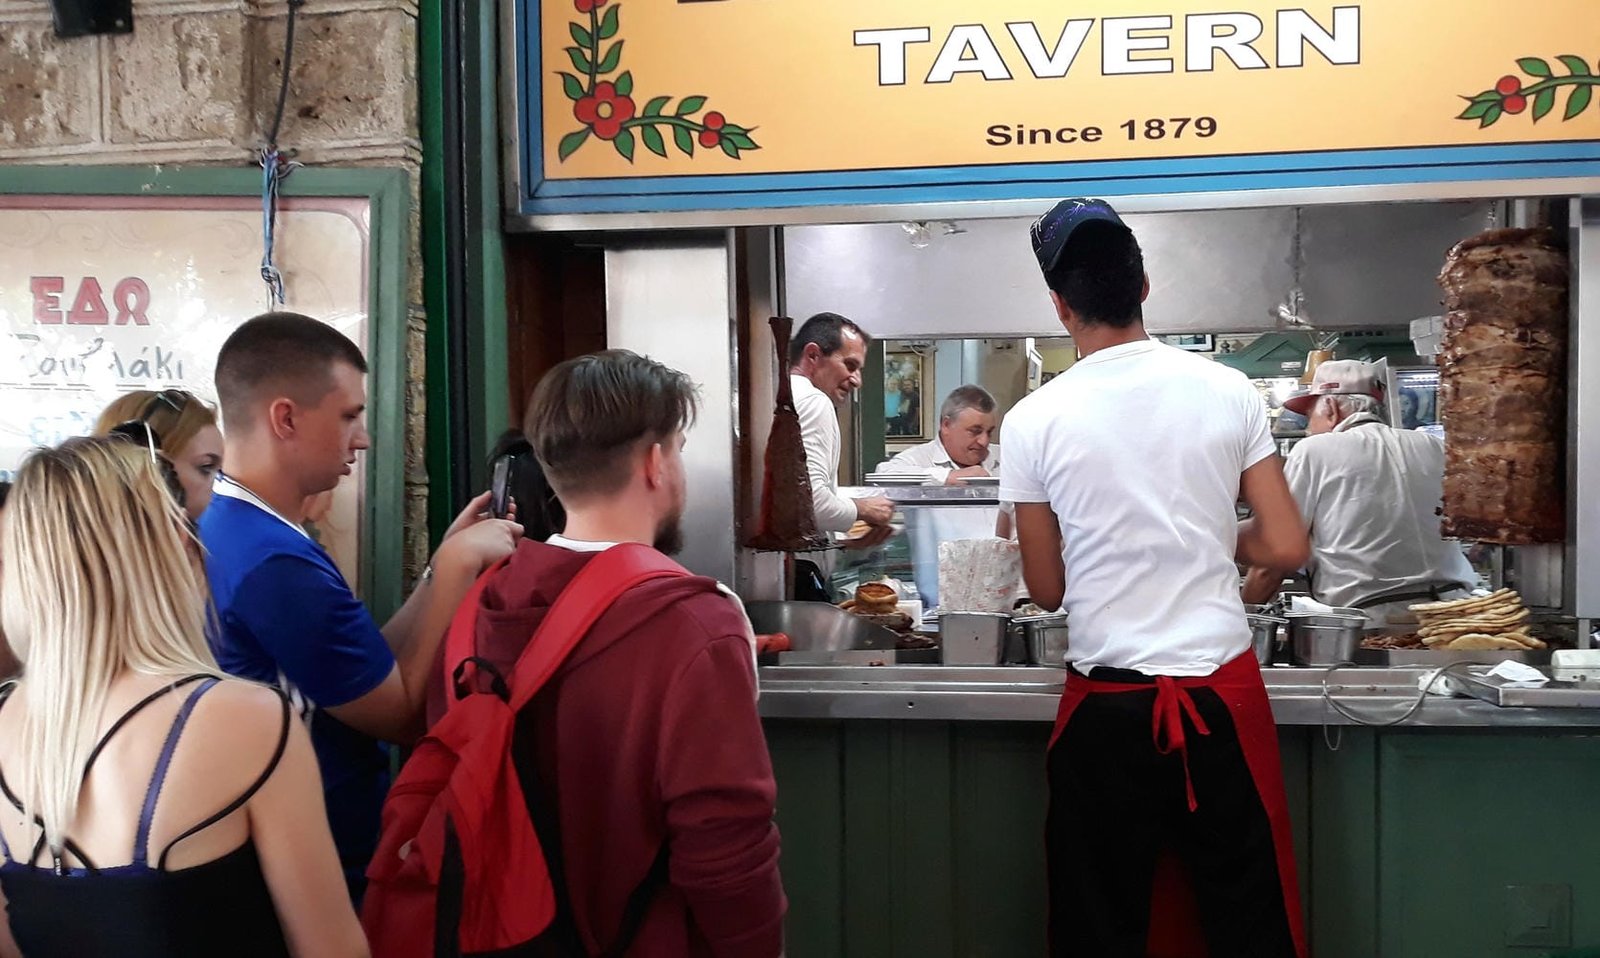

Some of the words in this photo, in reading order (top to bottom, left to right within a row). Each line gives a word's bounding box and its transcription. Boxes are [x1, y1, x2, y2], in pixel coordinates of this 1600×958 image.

[853, 5, 1361, 87] TAVERN
[985, 124, 1103, 147] Since
[1120, 116, 1217, 141] 1879
[30, 276, 151, 325] ΕΔΩ
